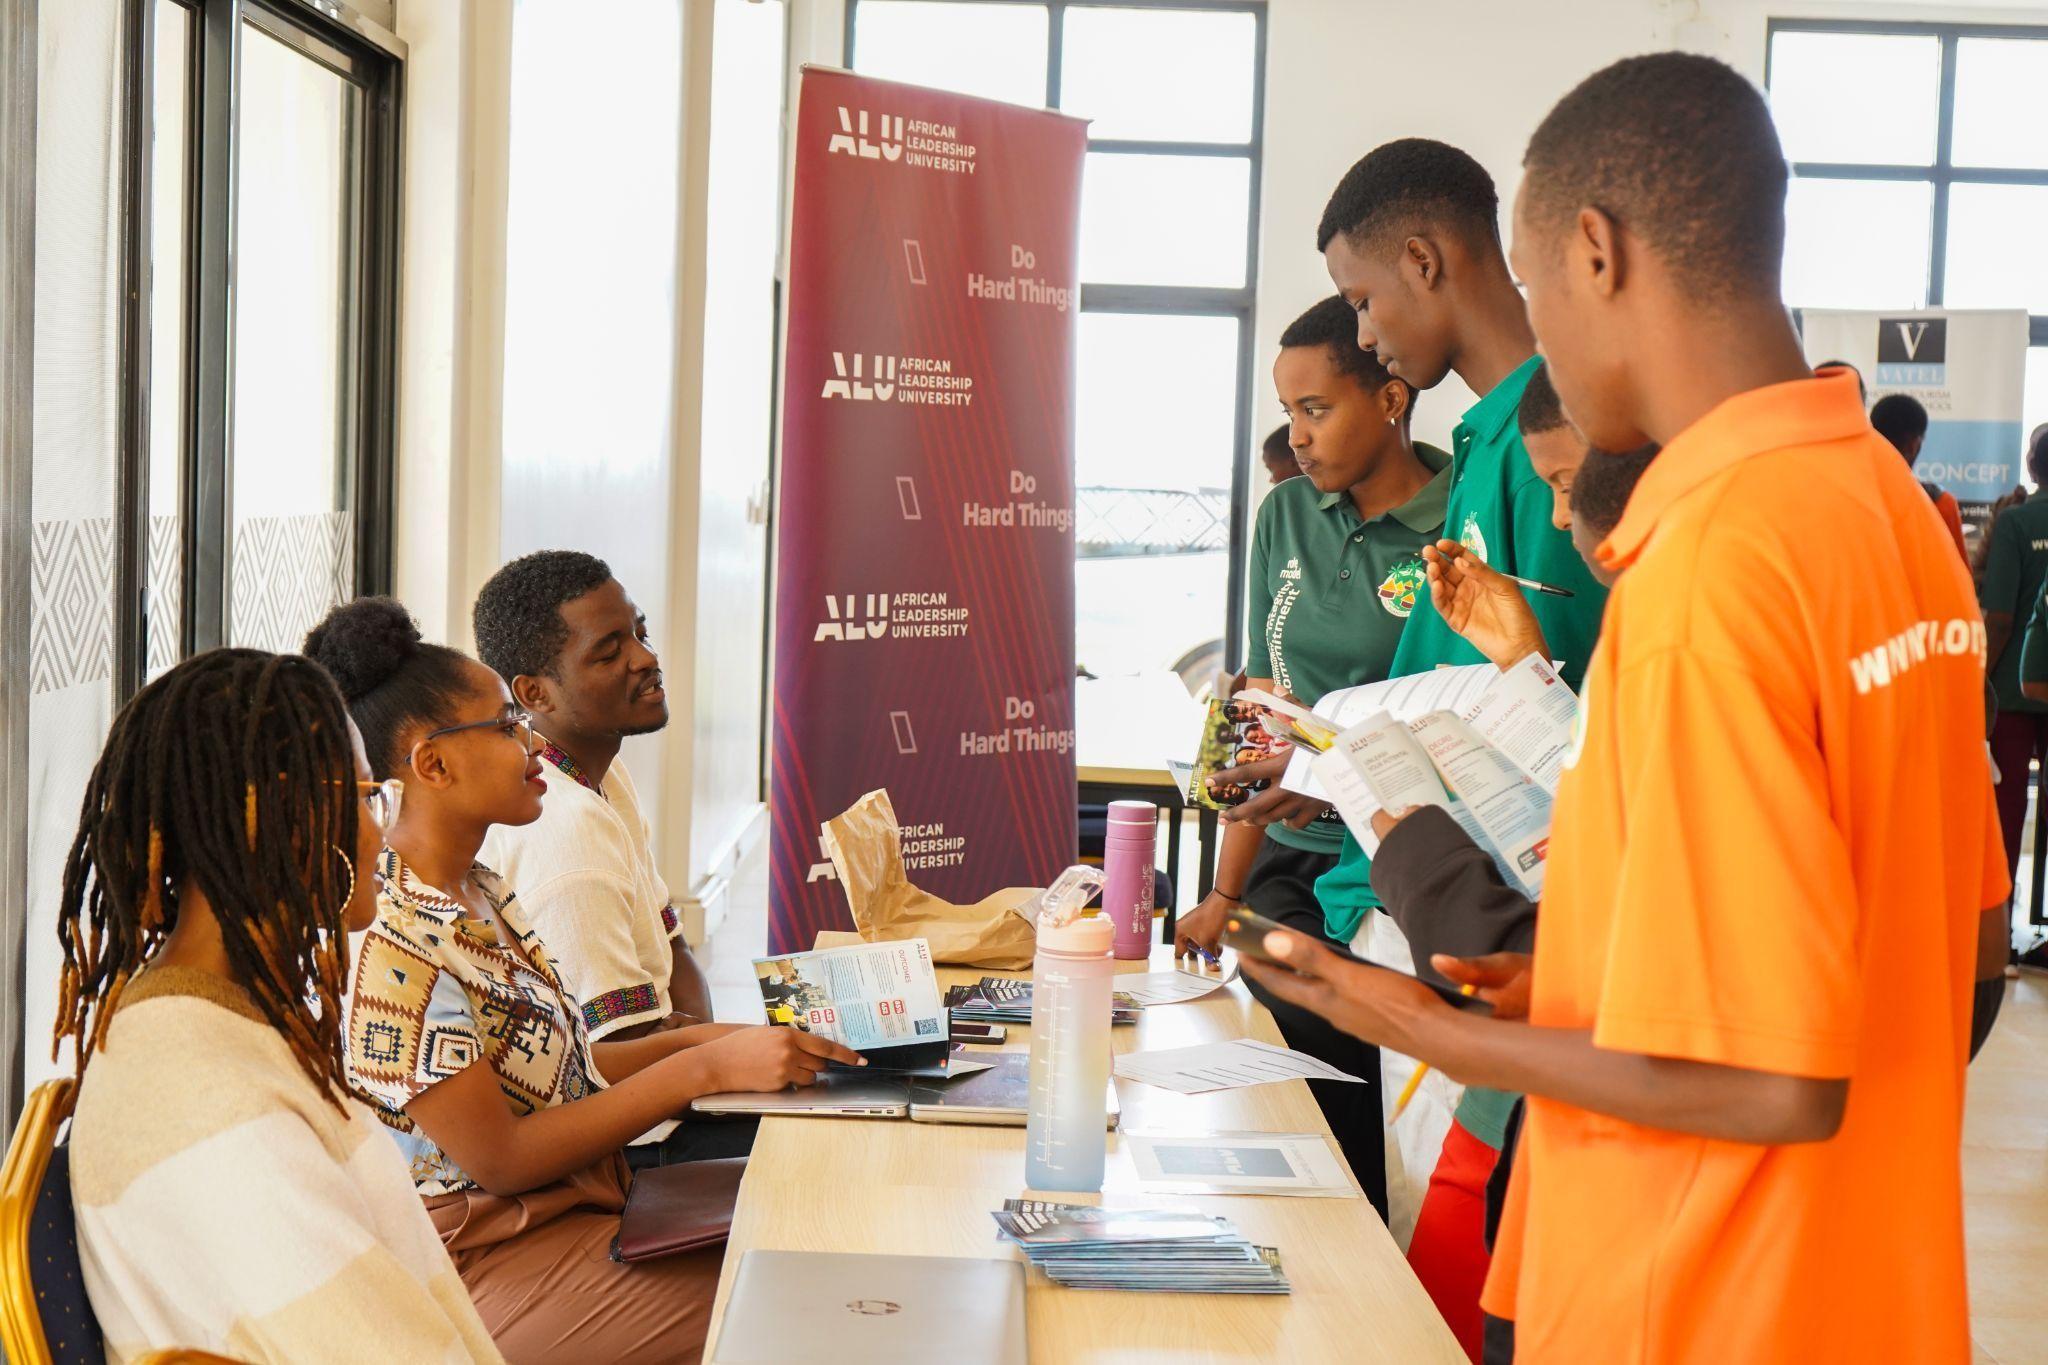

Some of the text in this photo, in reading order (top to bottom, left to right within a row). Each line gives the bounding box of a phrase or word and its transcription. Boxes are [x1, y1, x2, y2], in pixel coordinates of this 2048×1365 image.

[828, 106, 903, 161] ALU
[907, 119, 956, 139] AFRICAN
[906, 135, 976, 158] LEADERSHIP
[906, 154, 976, 174] UNIVERSITY
[1011, 244, 1035, 269] Do
[967, 273, 1074, 311] Hard Things
[1896, 322, 1929, 361] V
[900, 357, 951, 372] AFRICAN
[821, 352, 895, 401] ALU
[898, 373, 973, 390] LEADERSHIP
[898, 390, 972, 406] UNIVERSITY
[1010, 470, 1036, 494] Do
[1914, 461, 2010, 484] CONCEPT
[963, 502, 1073, 532] Hard Things
[893, 593, 947, 606] AFRICAN
[814, 594, 888, 642] ALU
[892, 608, 968, 622] LEADERSHIP
[892, 624, 968, 638] UNIVERSITY
[1271, 589, 1300, 694] ommitment
[1005, 697, 1034, 719] Do
[960, 724, 1075, 755] Hard Things
[897, 823, 944, 836] FRICAN
[901, 837, 965, 855] ADERSHIP
[902, 852, 965, 870] IVERSITY
[898, 949, 912, 984] OUTCOMES
